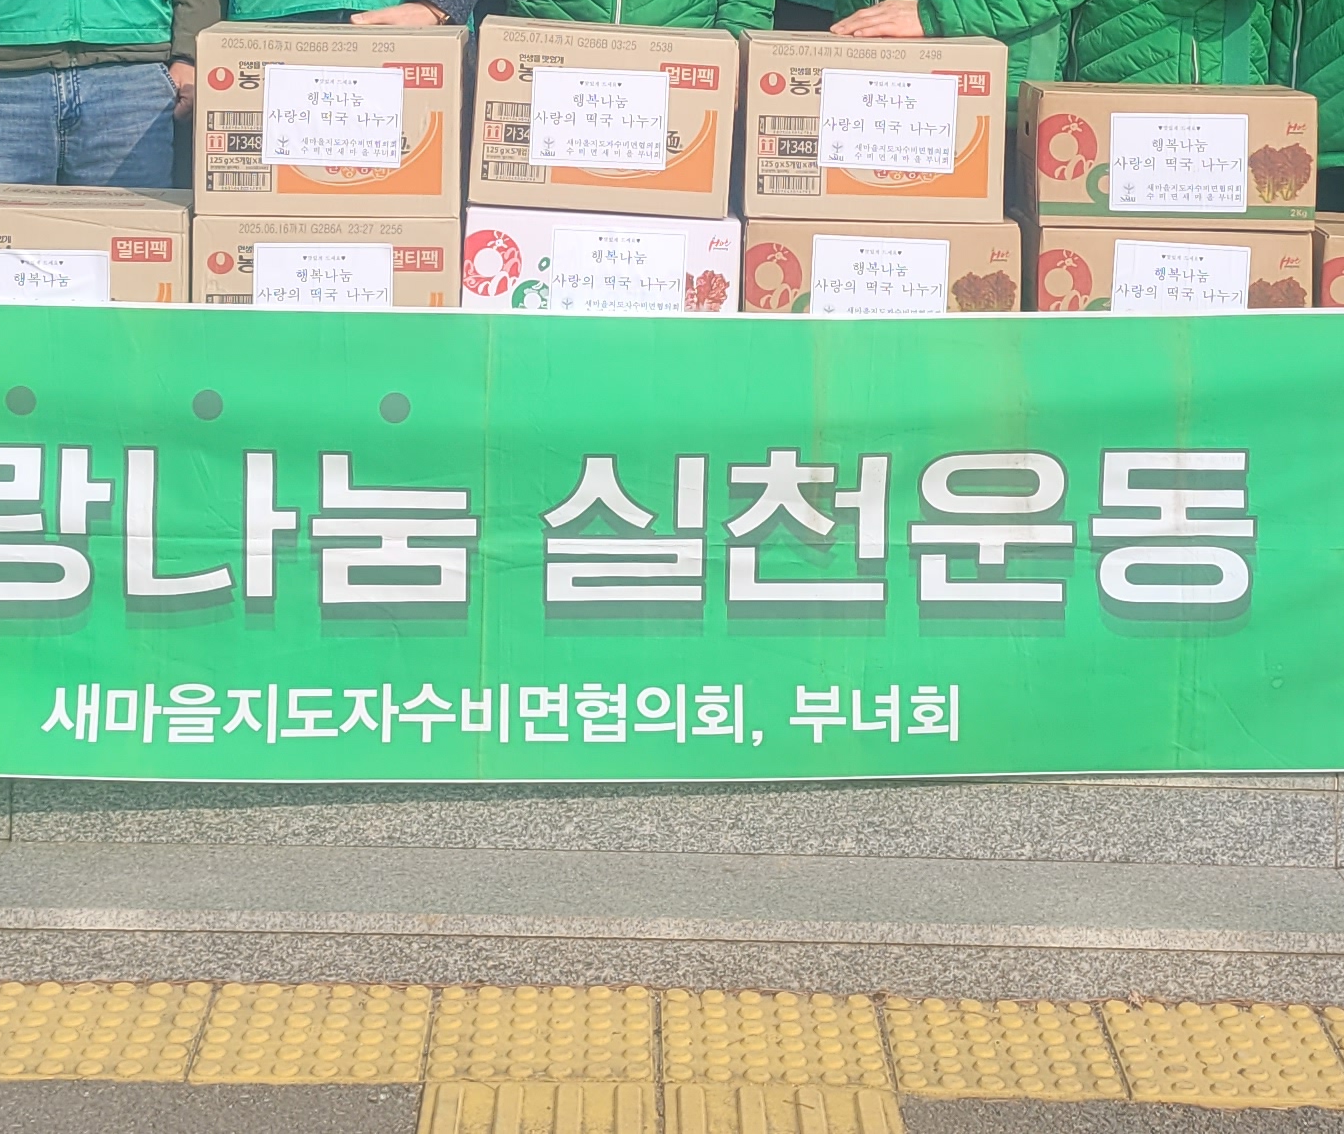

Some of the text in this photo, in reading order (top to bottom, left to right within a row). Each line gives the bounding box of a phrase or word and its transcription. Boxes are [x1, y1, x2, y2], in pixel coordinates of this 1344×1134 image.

[331, 42, 358, 52] 23:29
[372, 42, 395, 53] 2293
[611, 39, 637, 51] 03:25
[649, 41, 673, 53] 2538
[880, 49, 906, 60] 03:20
[919, 49, 942, 60] 2498
[238, 70, 264, 90] 농
[403, 66, 438, 86] 티팩
[664, 66, 715, 88] 멀티팩
[957, 73, 986, 94] 티팩
[307, 91, 364, 107] 행복나눔
[573, 93, 628, 109] 행복나눔
[862, 93, 917, 110] 행복나눔
[268, 108, 399, 128] 사랑의 떡국 나누기
[534, 110, 663, 129] 사랑의 떡국 나누기
[822, 116, 951, 138] 사랑의 떡국 나누기
[1152, 137, 1209, 153] 행복나눔
[1113, 156, 1243, 172] 사랑의 떡국 나누기
[348, 223, 374, 235] 23:27
[380, 224, 403, 235] 2256
[116, 239, 167, 260] 멀티팩
[591, 249, 648, 265] 행복나눔
[295, 268, 353, 283] 행복나눔
[853, 261, 909, 277] 행복나눔
[1154, 266, 1210, 283] 행복나눔
[14, 272, 71, 288] 행복나눔
[552, 273, 681, 292] 사랑의 떡국 나누기
[814, 278, 943, 298] 사랑의 떡국 나누기
[256, 287, 389, 302] 사랑의 떡국 나누기
[1115, 283, 1244, 305] 사랑의 떡국 나누기
[540, 447, 1257, 608] 실천운동
[40, 682, 960, 747] 새마을지도자수비면협의회, 부녀회
